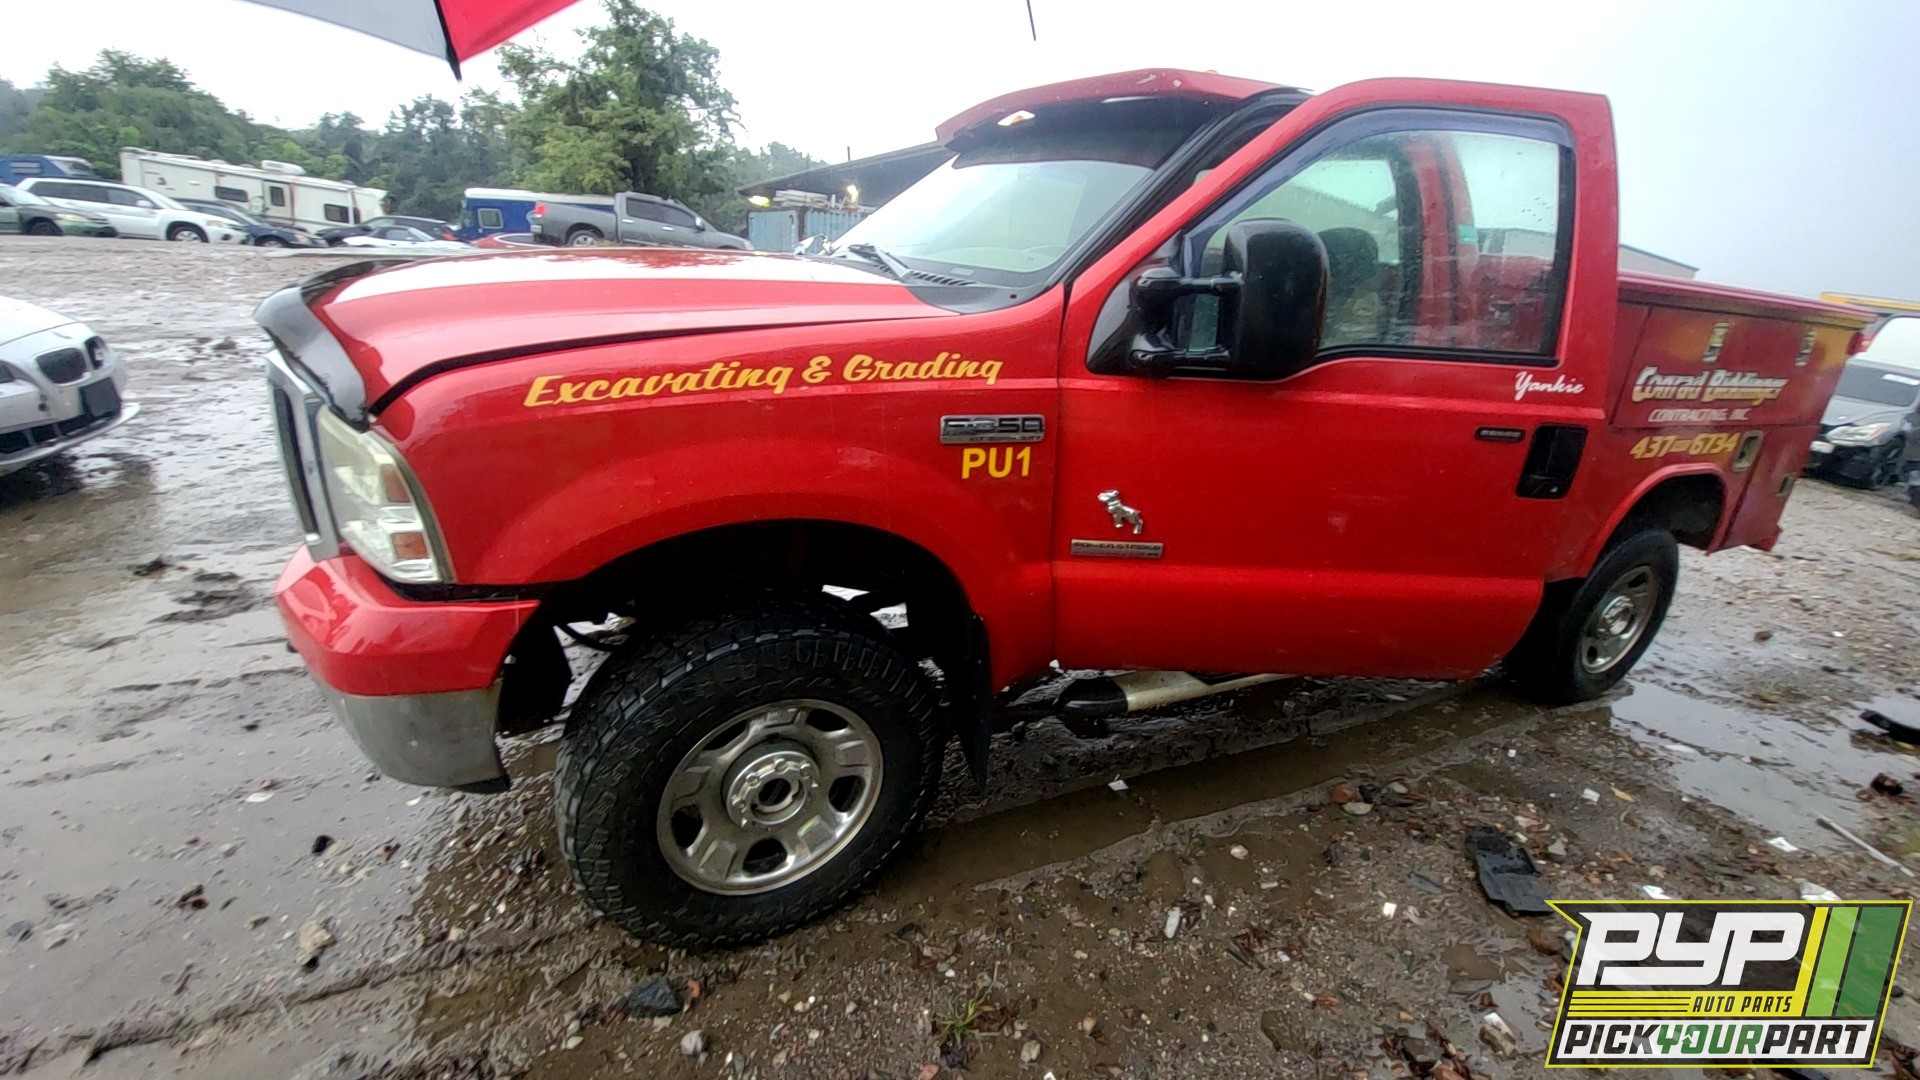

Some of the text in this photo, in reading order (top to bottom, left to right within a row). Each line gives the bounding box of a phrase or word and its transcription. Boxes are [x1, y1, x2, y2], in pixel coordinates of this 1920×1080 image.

[523, 352, 1003, 407] Excavating & Grading
[961, 446, 1031, 479] PU1
